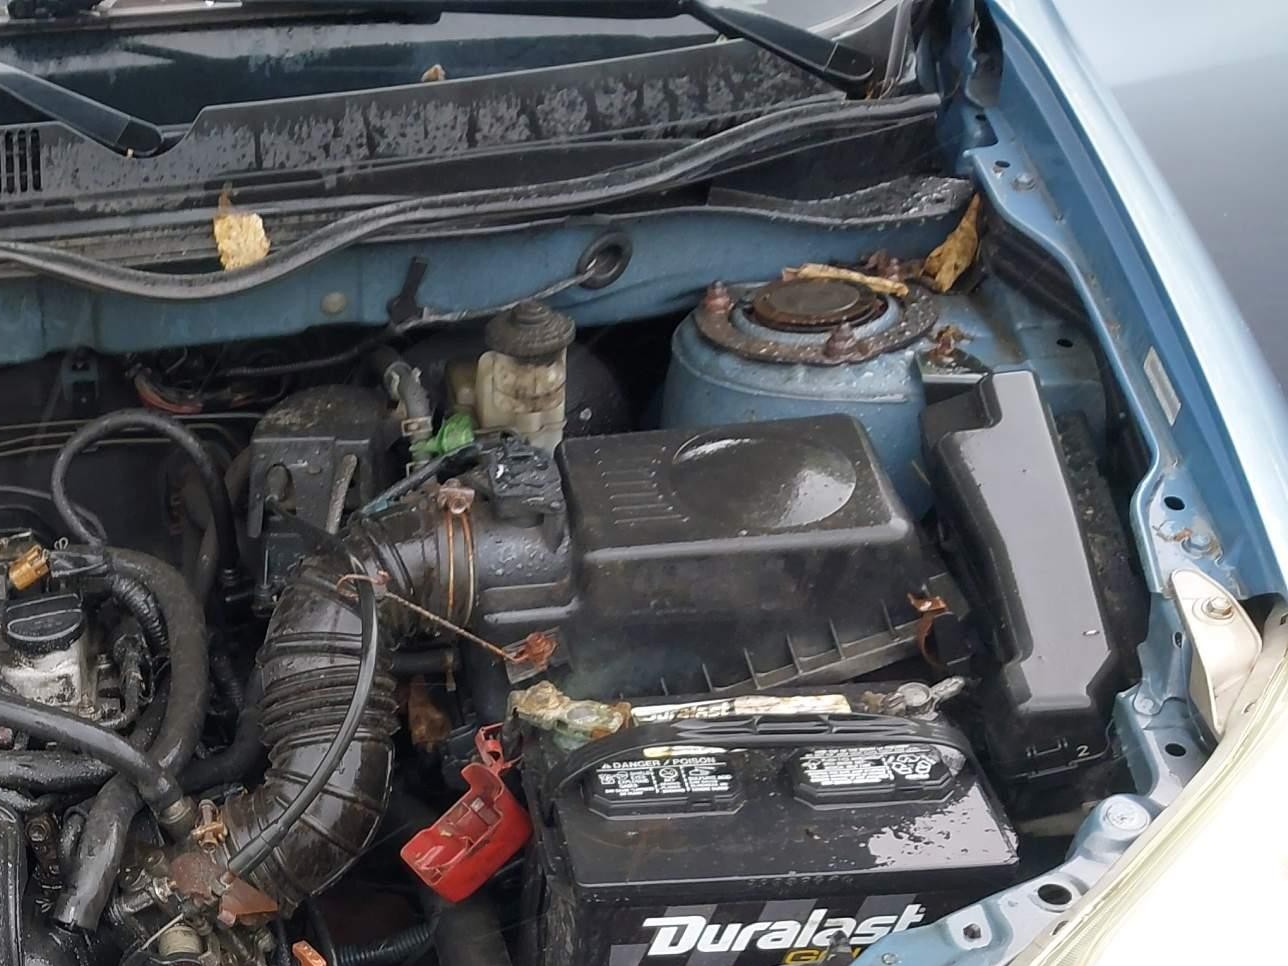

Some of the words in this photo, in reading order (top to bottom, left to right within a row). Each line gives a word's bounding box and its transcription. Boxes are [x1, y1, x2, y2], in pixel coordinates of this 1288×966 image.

[612, 759, 661, 769] DANGER
[672, 756, 716, 766] POISON
[642, 904, 926, 957] Duralast
